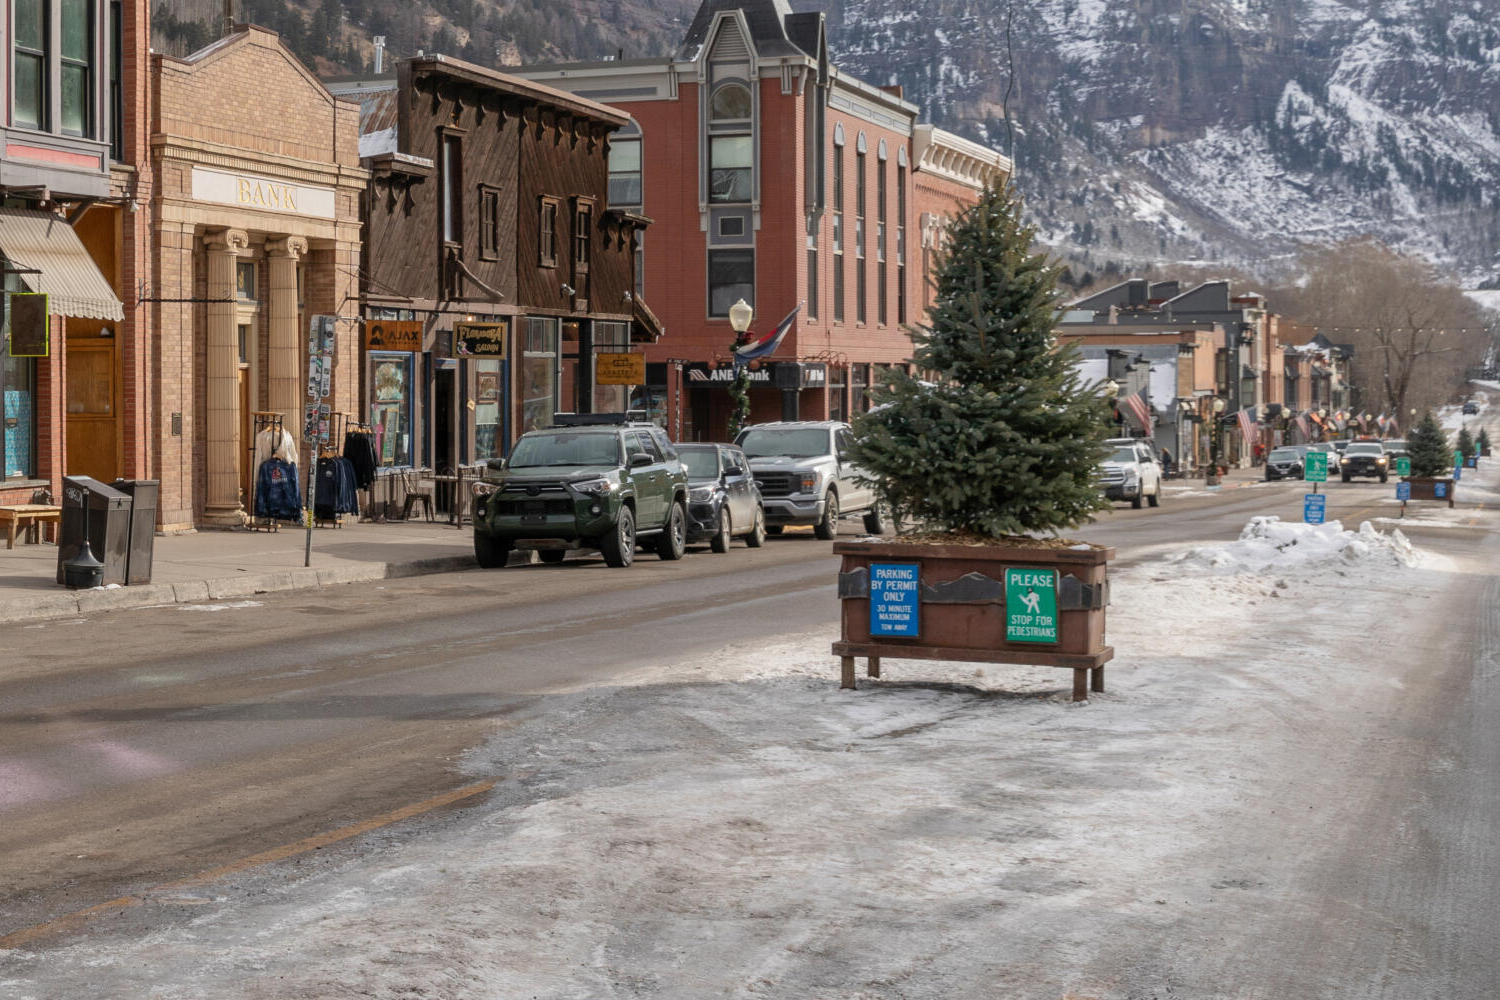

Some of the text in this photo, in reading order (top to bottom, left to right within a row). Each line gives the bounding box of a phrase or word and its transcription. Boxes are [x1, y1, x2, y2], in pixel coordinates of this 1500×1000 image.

[237, 179, 297, 210] BANK
[386, 331, 419, 341] AJAX
[876, 569, 913, 579] PARKING
[871, 580, 917, 590] BY PERMIT
[1011, 574, 1054, 587] PLEASE
[883, 592, 905, 602] ONLY
[877, 604, 912, 613] 30 MINUTE
[1011, 615, 1053, 626] STOP FOR
[1007, 626, 1056, 638] PEDESTRIANS
